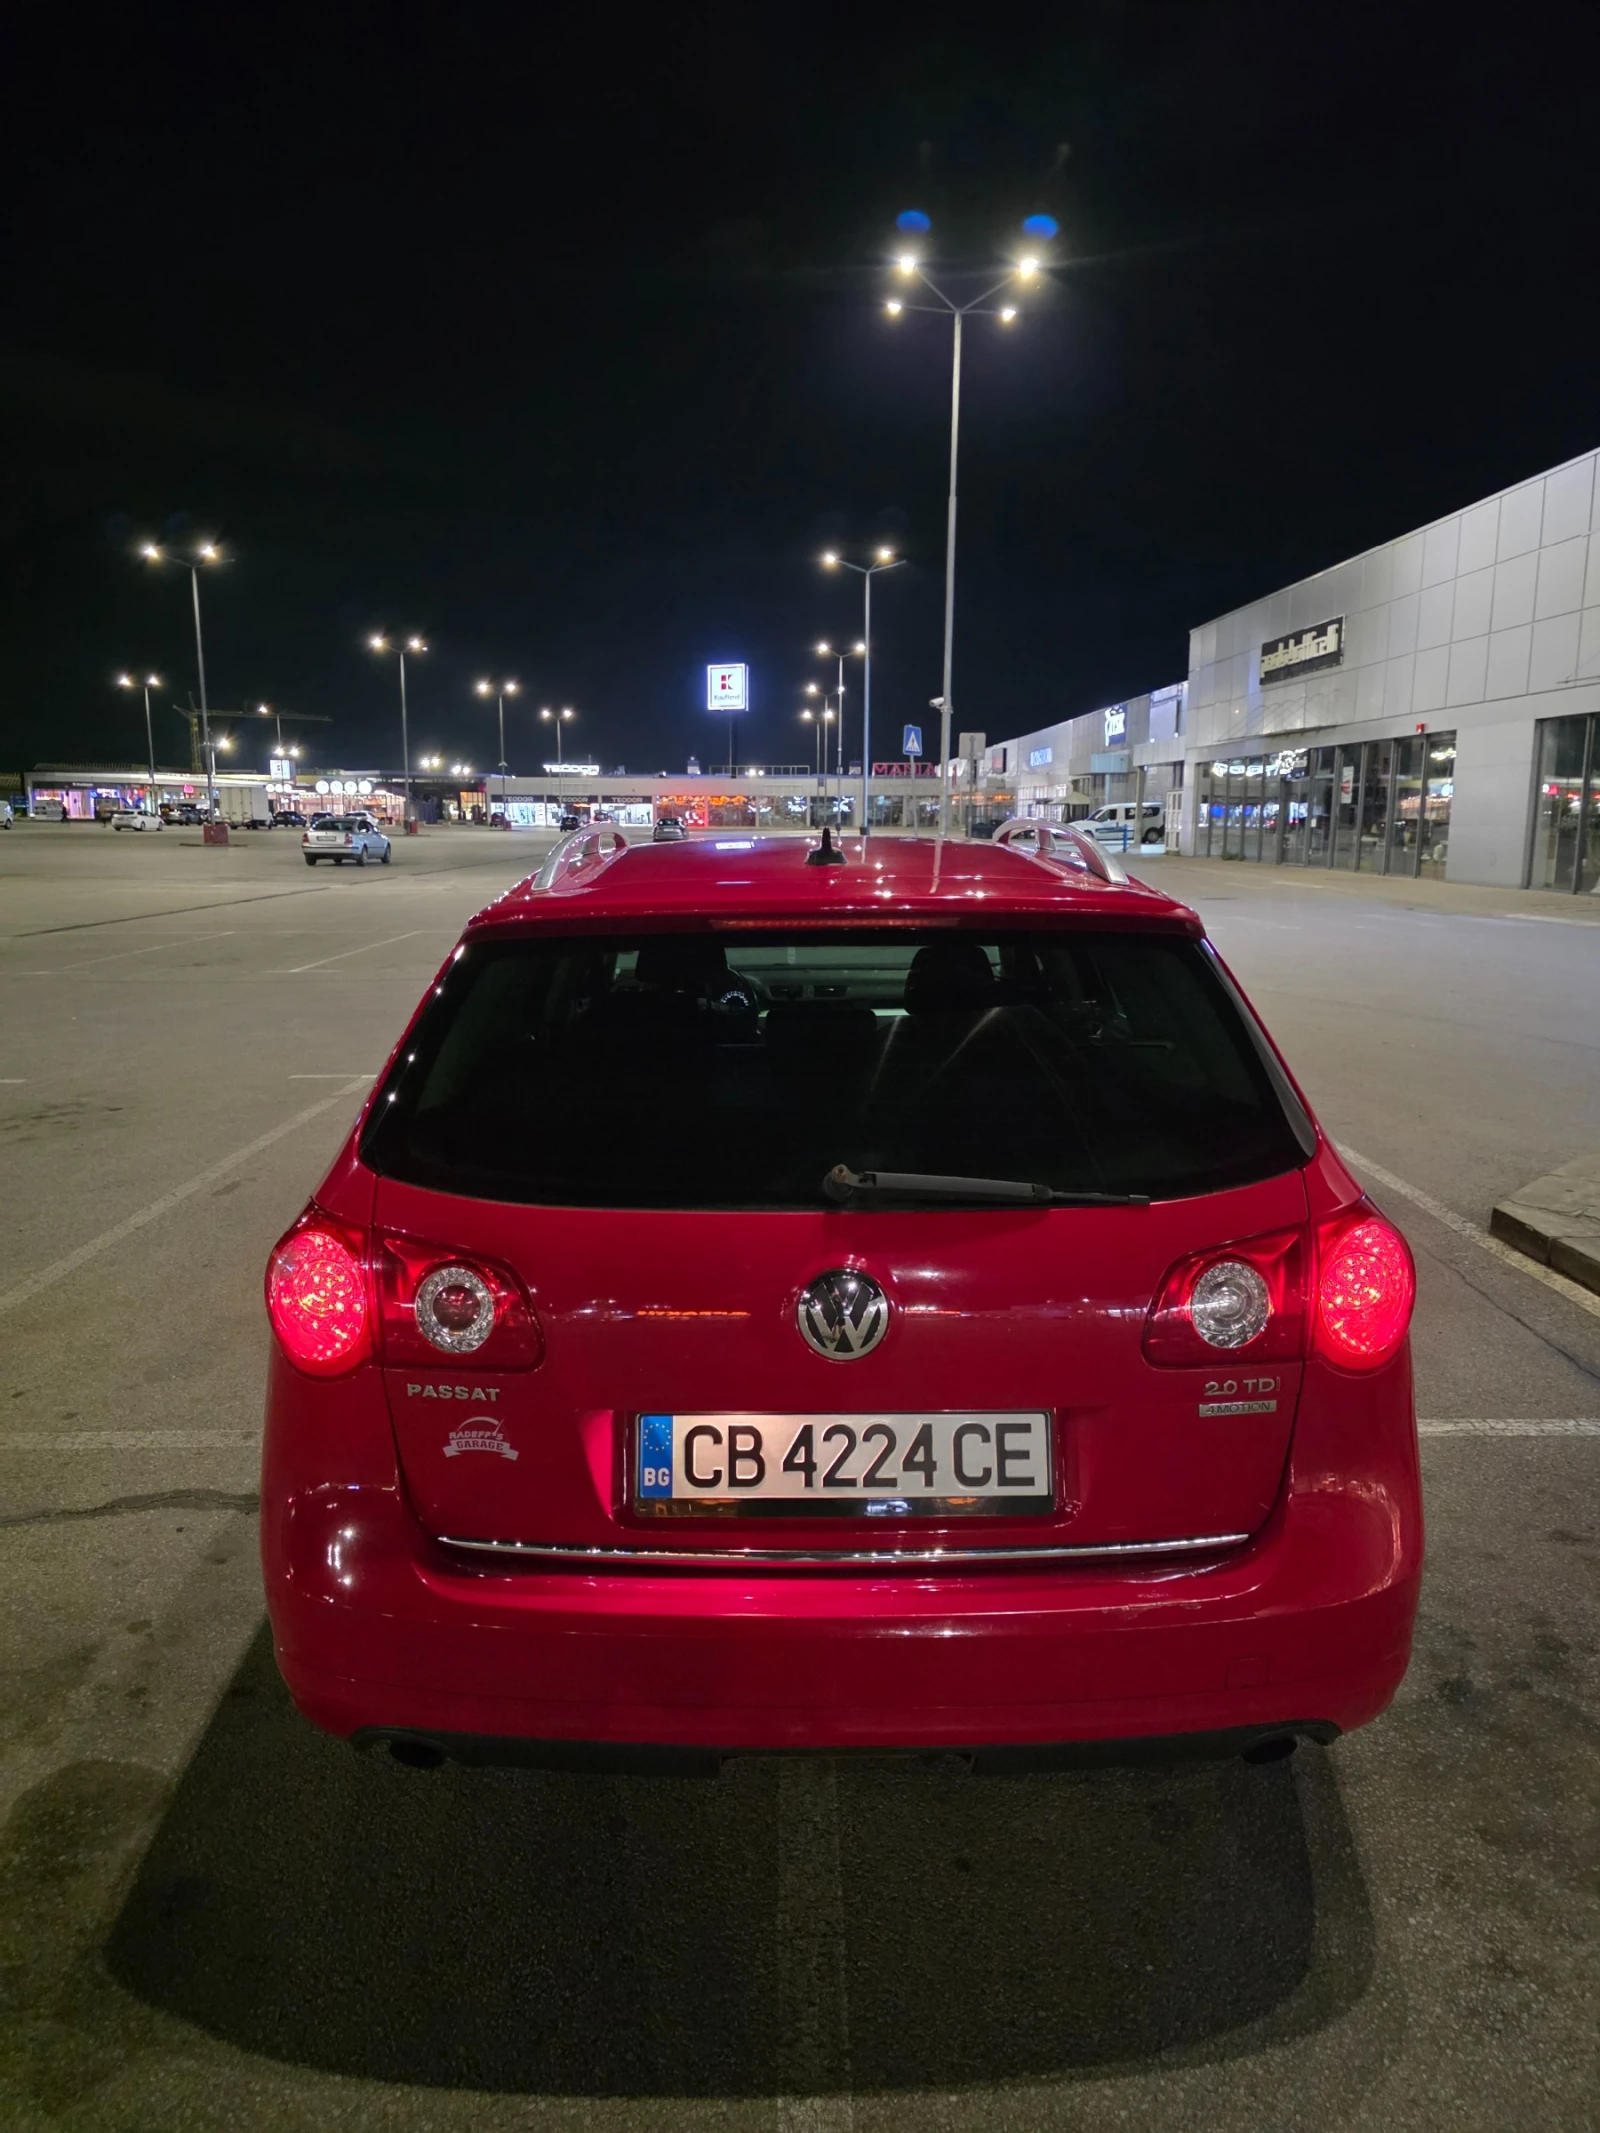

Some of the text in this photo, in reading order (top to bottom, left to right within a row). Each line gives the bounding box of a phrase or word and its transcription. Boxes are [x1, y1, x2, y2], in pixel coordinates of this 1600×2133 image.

[407, 1383, 500, 1402] PASSAT
[1242, 1376, 1281, 1393] TDI
[1206, 1402, 1271, 1414] 4MOTION
[456, 1440, 504, 1451] GARAGE
[684, 1423, 1036, 1488] CB 4224 CE
[643, 1467, 670, 1487] BG
